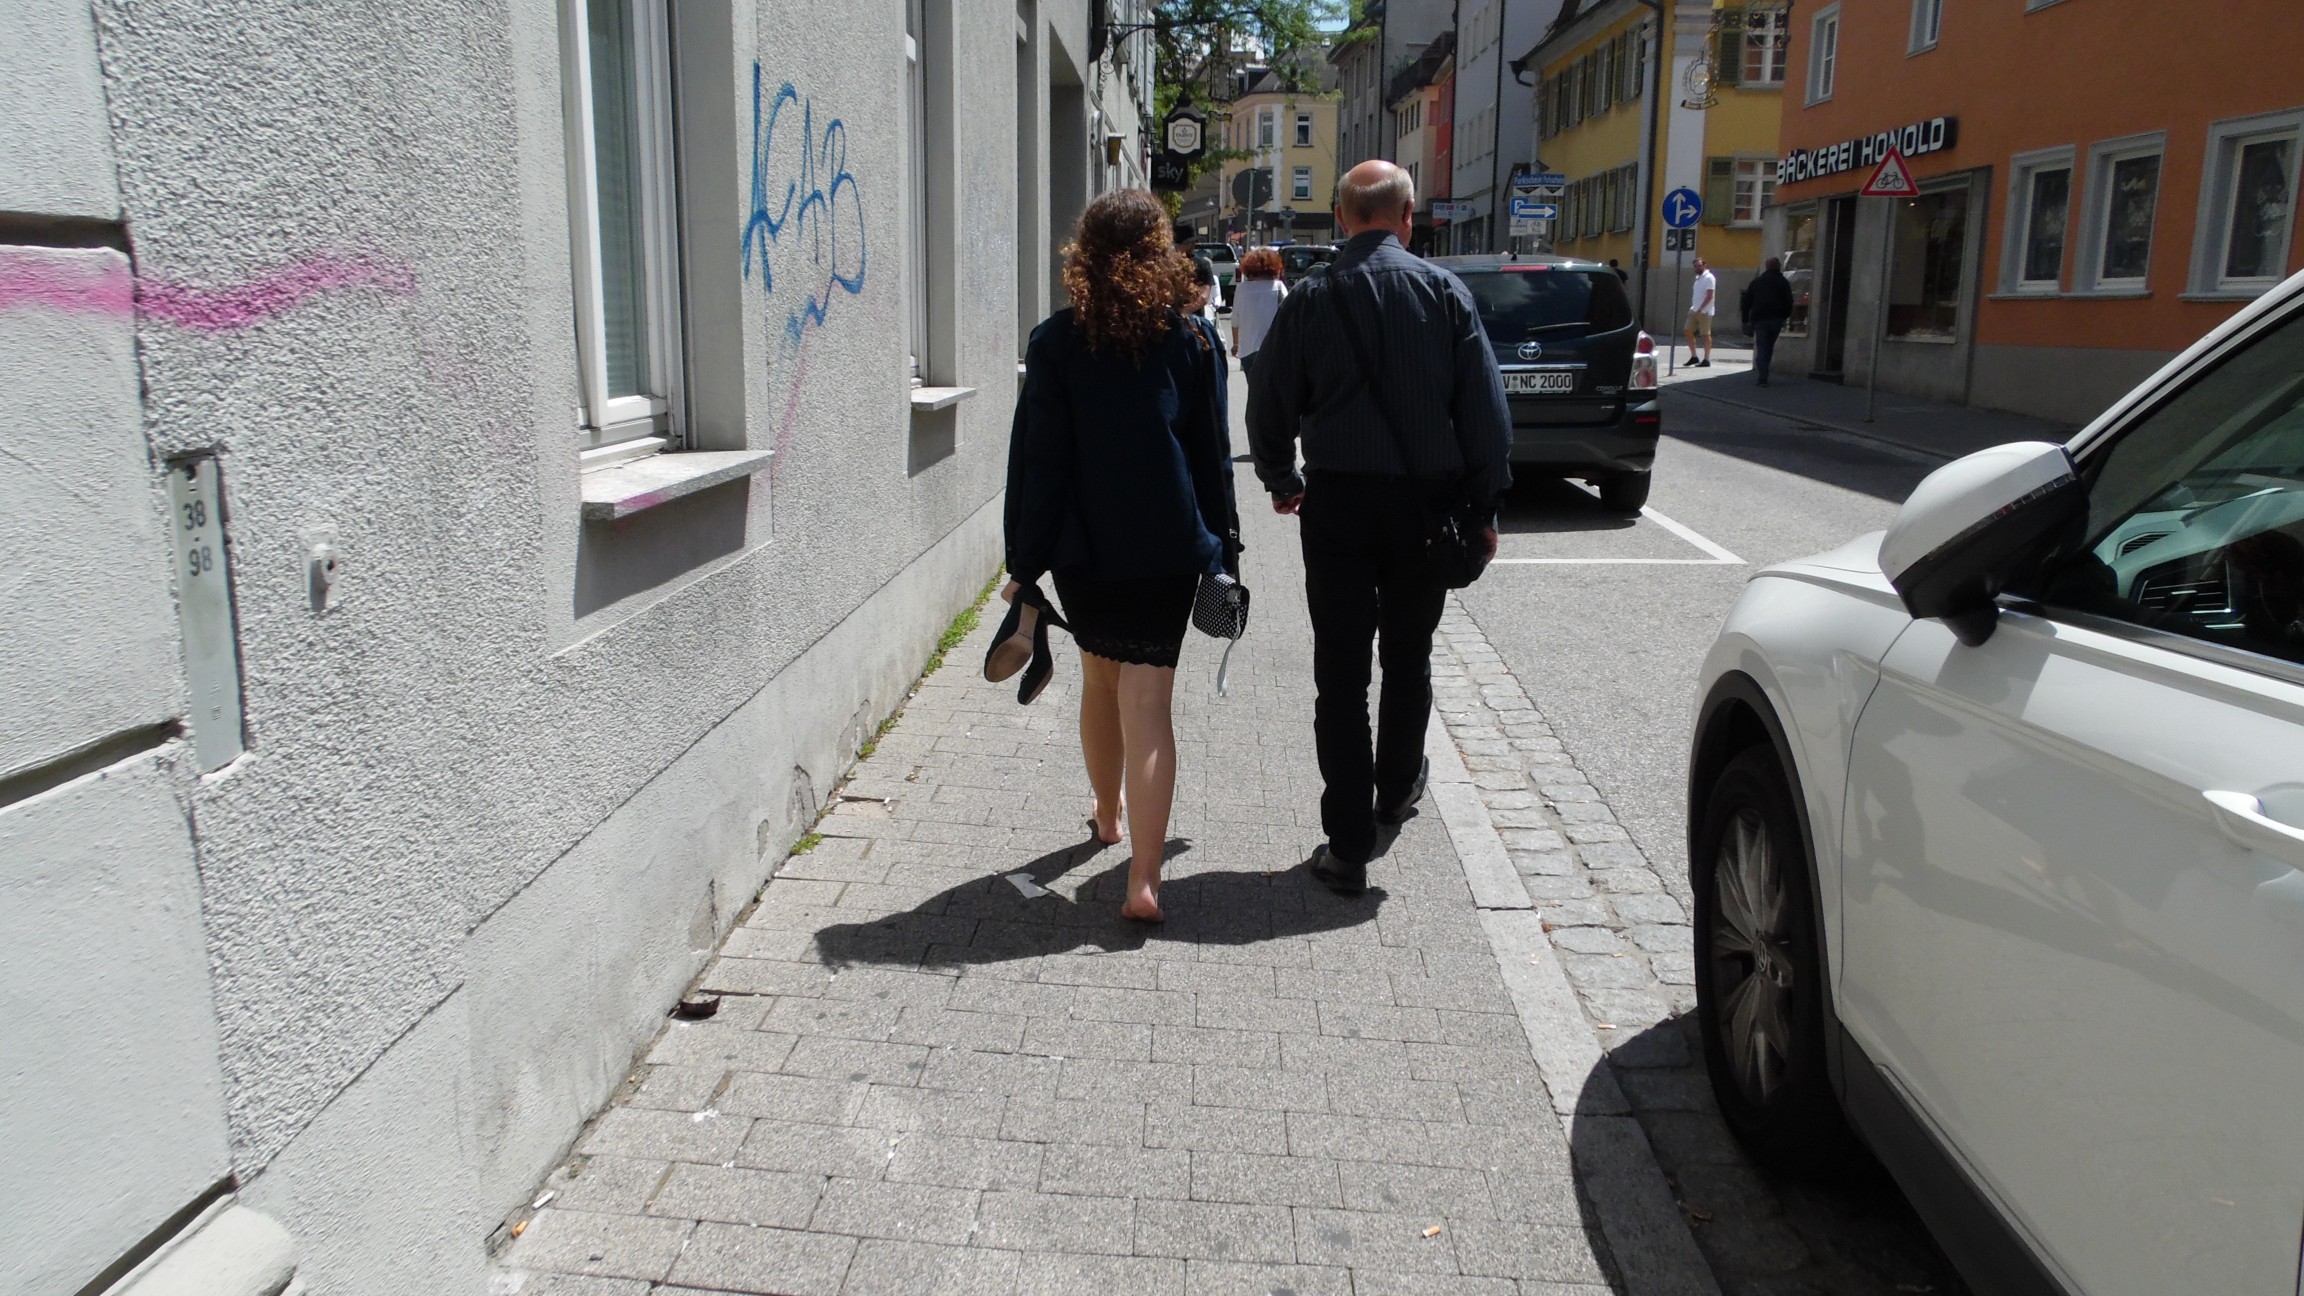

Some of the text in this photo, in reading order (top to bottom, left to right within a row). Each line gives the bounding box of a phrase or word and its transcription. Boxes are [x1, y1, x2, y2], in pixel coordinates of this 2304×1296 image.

[1776, 117, 1945, 185] BÄCKEREI HONOLD
[1157, 161, 1184, 184] sky
[1520, 375, 1536, 389] NC
[1540, 374, 1571, 389] 2000
[183, 499, 207, 531] 38
[189, 545, 213, 576] 98
